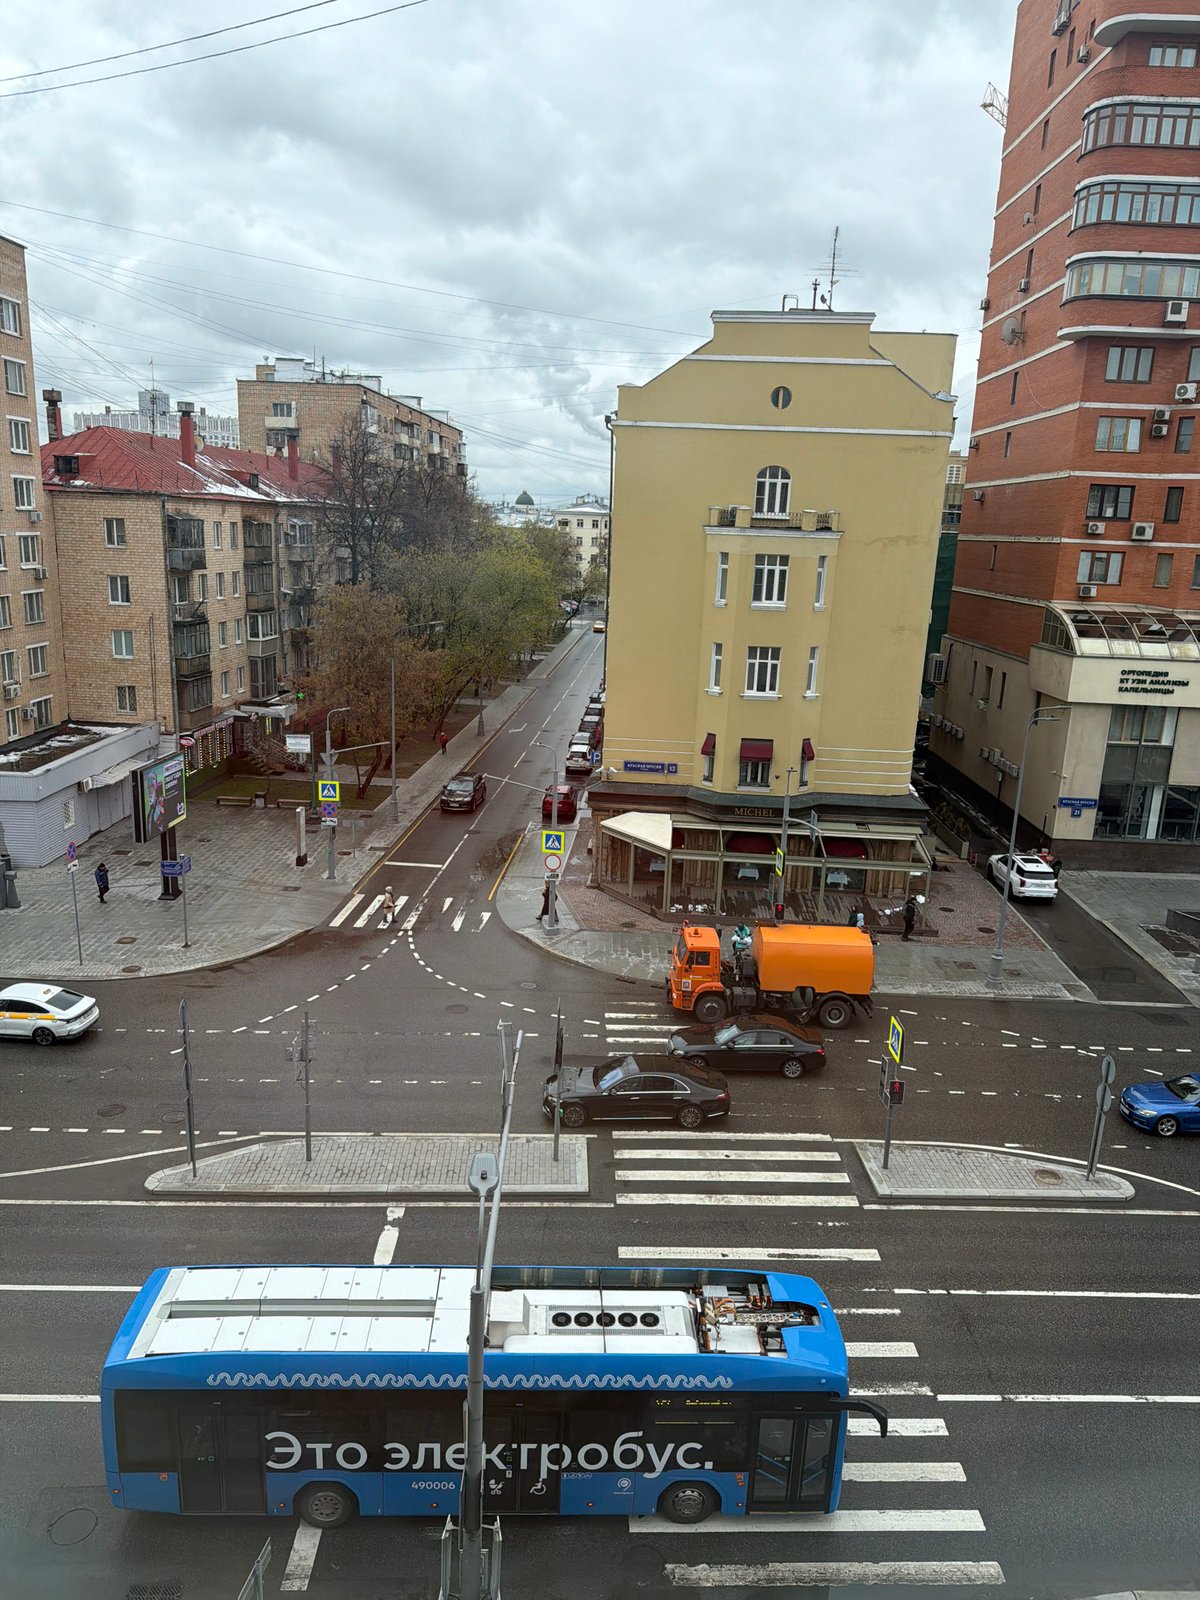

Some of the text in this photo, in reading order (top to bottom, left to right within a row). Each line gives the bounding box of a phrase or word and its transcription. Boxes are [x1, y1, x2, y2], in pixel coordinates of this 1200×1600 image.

[1121, 669, 1169, 677] ОРТОПЕДИЯ
[1149, 679, 1189, 687] АНАЛИЗЫ
[1118, 686, 1174, 695] КАПЕЛЬНИЦЫ
[734, 807, 776, 817] MICHEL
[264, 1430, 714, 1479] Это электробус.
[411, 1481, 456, 1490] 490006
